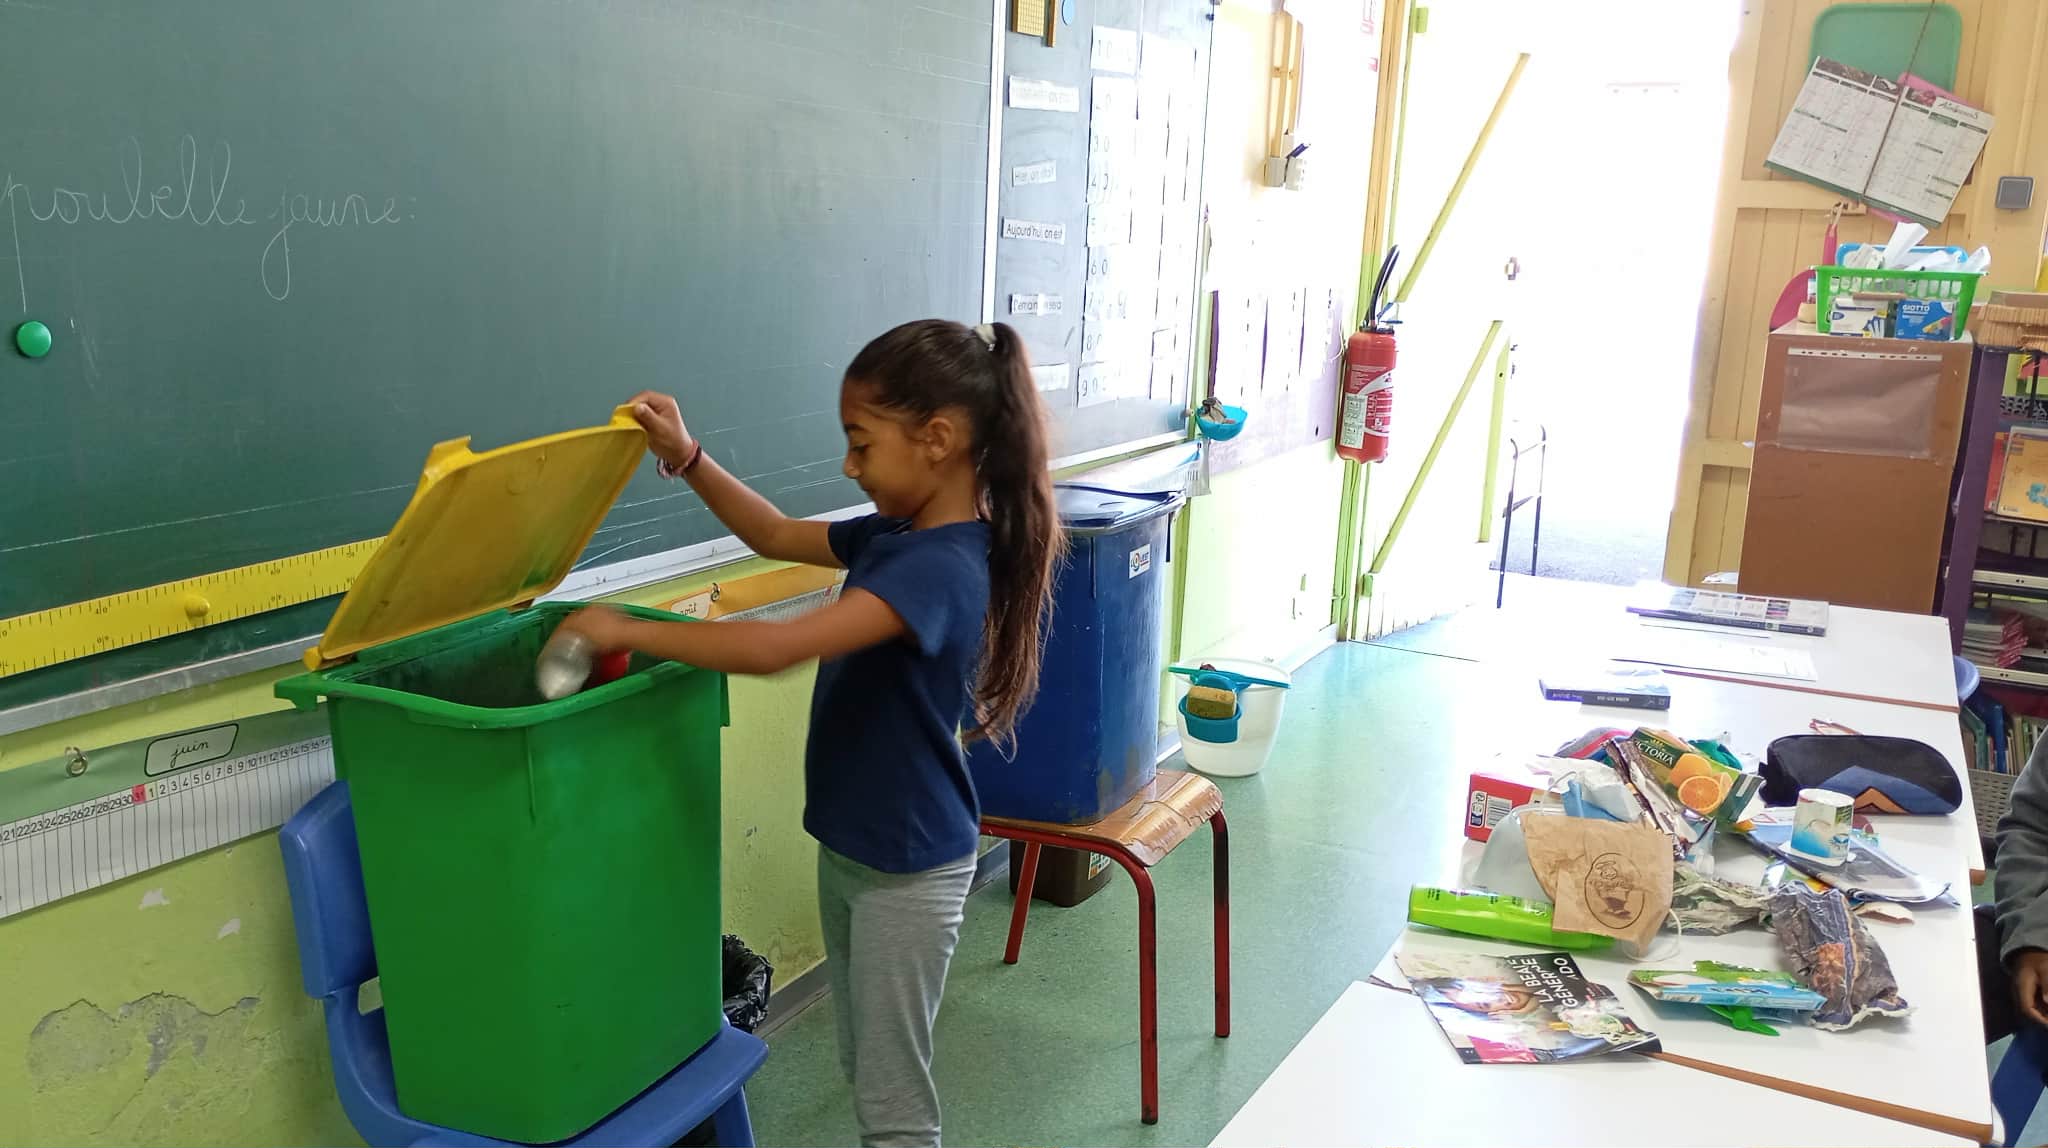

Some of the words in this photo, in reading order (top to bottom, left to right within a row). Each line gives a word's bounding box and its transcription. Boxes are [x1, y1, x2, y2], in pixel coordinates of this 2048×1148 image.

[0, 134, 256, 313] poubelle
[170, 741, 209, 768] juin
[4, 829, 15, 841] 21
[17, 826, 29, 837] 22
[31, 820, 43, 833] 23
[44, 817, 57, 829] 24
[58, 814, 70, 825] 25
[71, 810, 83, 822] 26
[84, 806, 96, 818] 27
[97, 802, 109, 814] 28
[110, 798, 122, 810] 29
[121, 794, 134, 807] 30
[248, 757, 257, 768] 10
[259, 755, 267, 765] 11
[270, 751, 279, 761] 12
[291, 745, 299, 756] 14
[301, 743, 310, 753] 15
[1534, 989, 1554, 1003] LA
